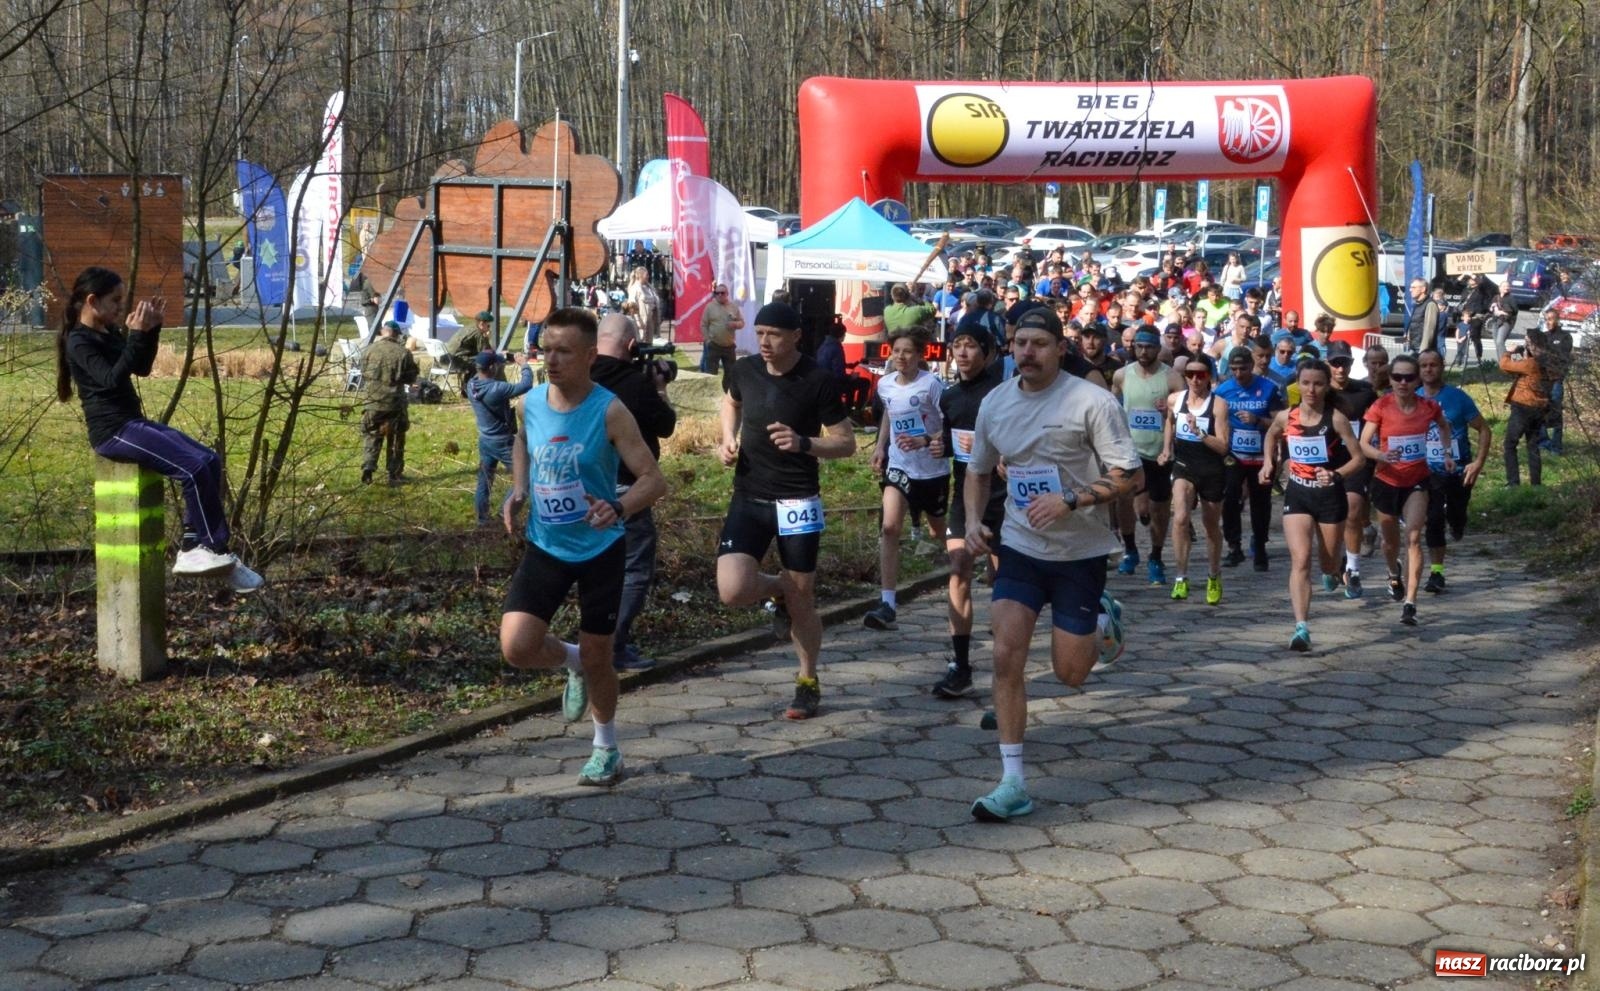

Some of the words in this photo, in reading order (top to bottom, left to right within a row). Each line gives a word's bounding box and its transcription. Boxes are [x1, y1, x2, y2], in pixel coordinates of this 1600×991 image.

[1077, 94, 1139, 109] BIEG
[964, 103, 1006, 118] SIR
[1026, 120, 1195, 139] TWARDZIELA
[1040, 145, 1176, 167] RACIBÓRZ
[1455, 254, 1486, 263] VAMOS
[895, 418, 915, 430] 037
[1135, 415, 1156, 425] 023
[533, 443, 584, 475] NEVER
[1294, 446, 1320, 457] 090
[1017, 481, 1051, 497] 055
[544, 497, 576, 513] 120
[787, 508, 818, 524] 043
